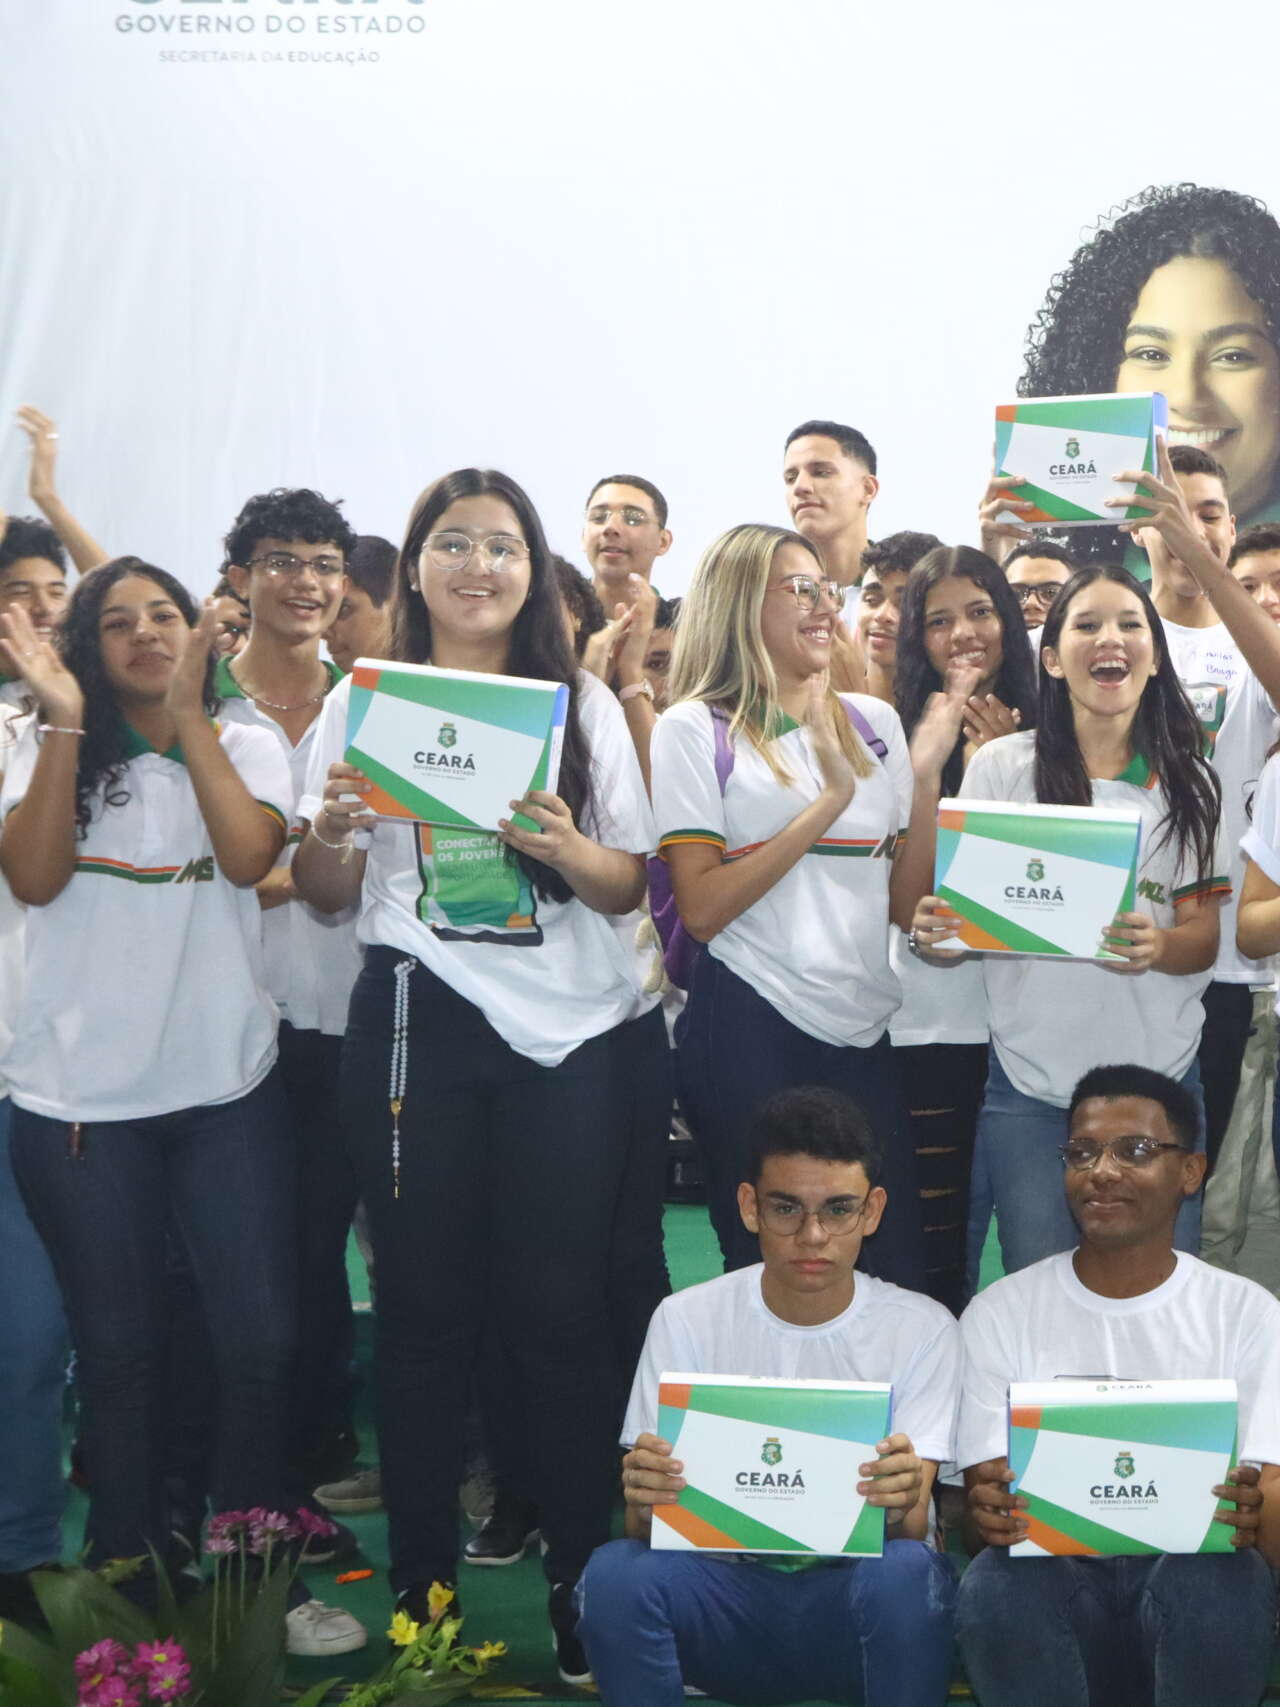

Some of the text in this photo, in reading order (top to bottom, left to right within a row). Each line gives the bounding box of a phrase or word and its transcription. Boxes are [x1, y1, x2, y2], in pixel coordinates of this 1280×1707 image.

[115, 14, 425, 33] GOVERNO DO ESTADO
[158, 48, 381, 66] SECRETARIA DA EDUCAÇÃO
[1048, 459, 1097, 475] CEARÁ
[414, 751, 476, 770] CEARÁ
[1004, 885, 1065, 901] CEARÁ
[735, 1469, 805, 1488] CEARÁ
[1089, 1480, 1159, 1498] CEARÁ
